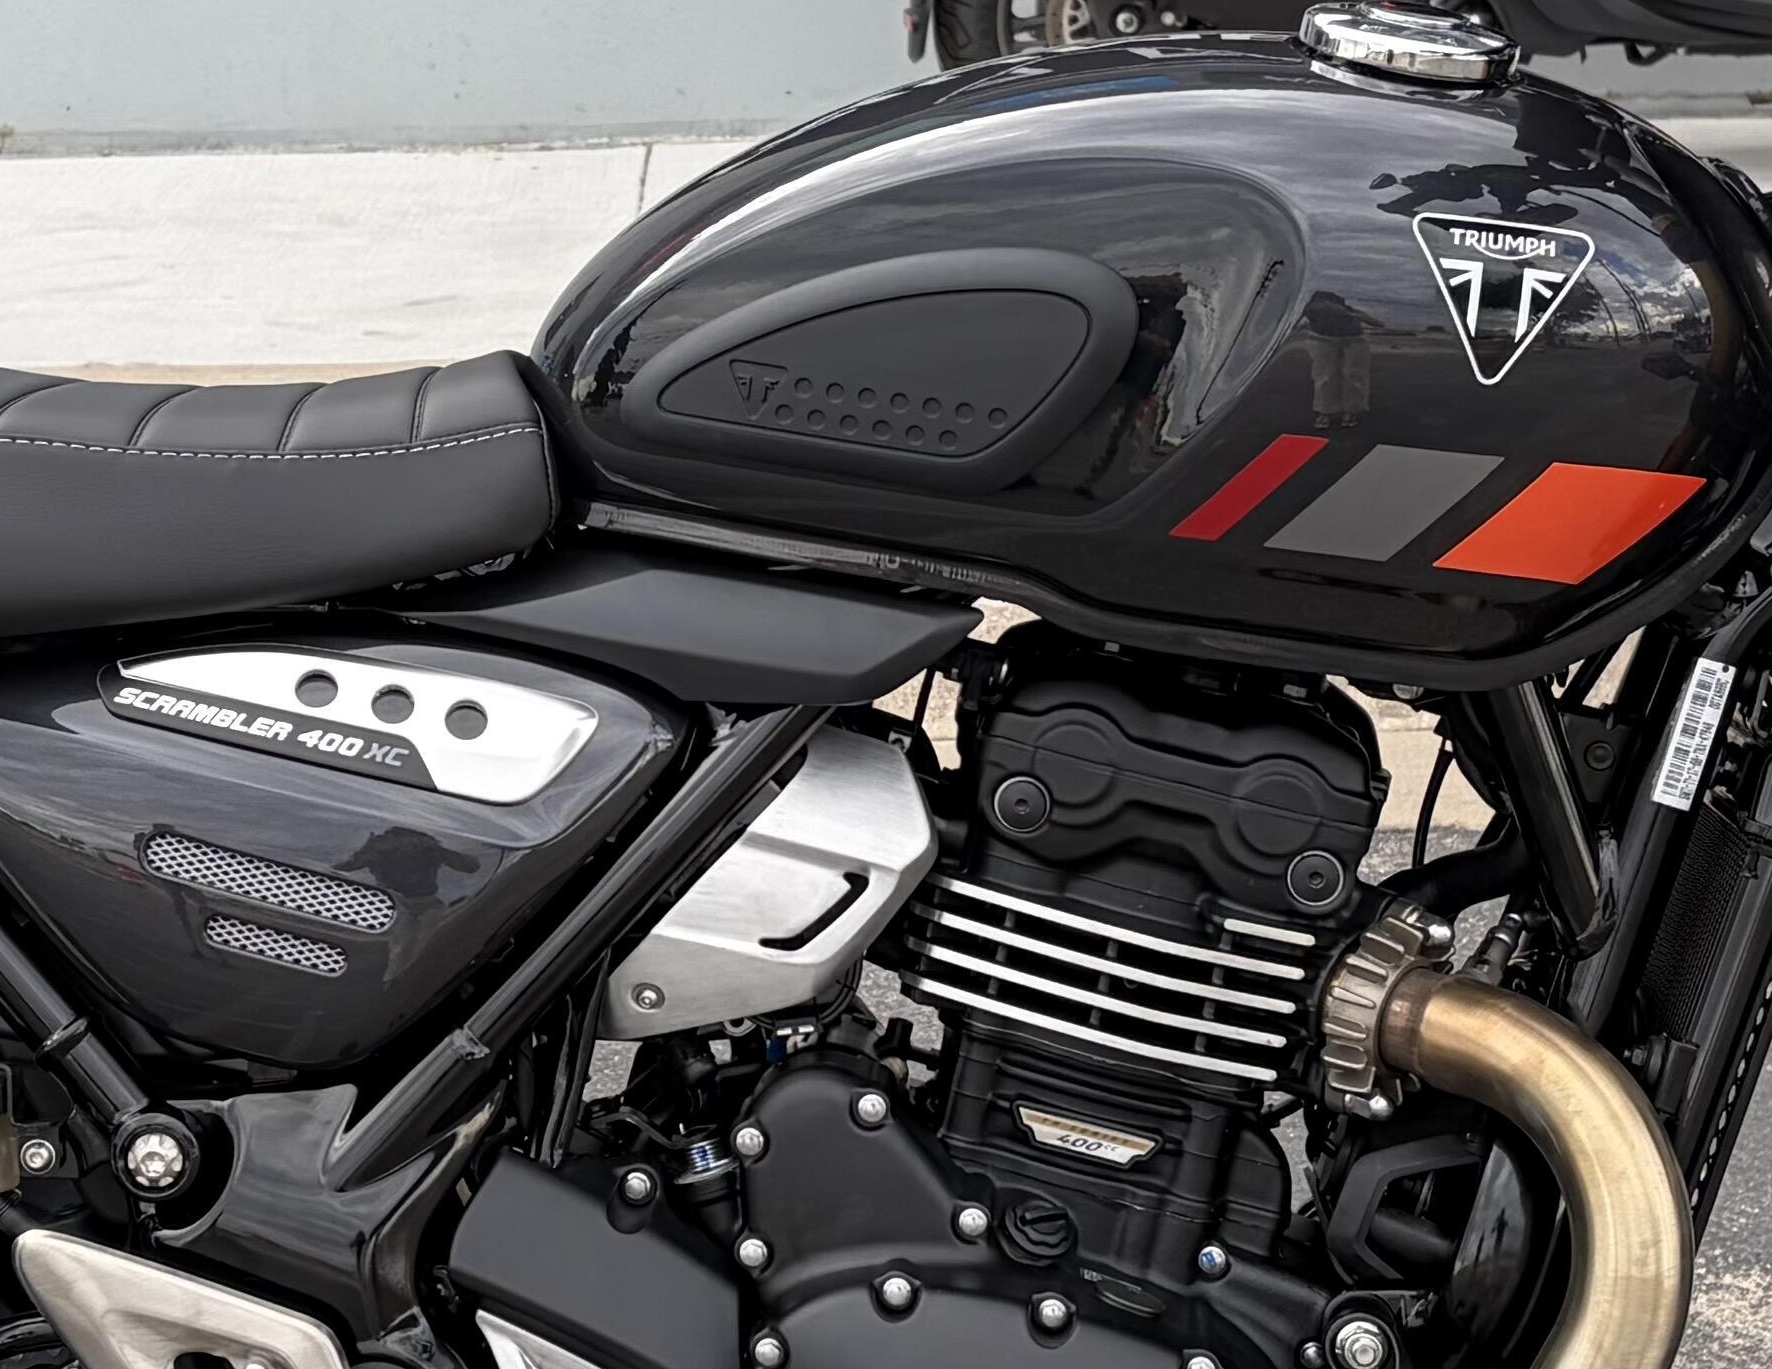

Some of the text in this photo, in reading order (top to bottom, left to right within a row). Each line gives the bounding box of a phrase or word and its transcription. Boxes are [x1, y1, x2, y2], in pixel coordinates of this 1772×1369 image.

[1449, 228, 1556, 261] TRIUMPH
[113, 687, 411, 767] SCRAMBLER 400 XC
